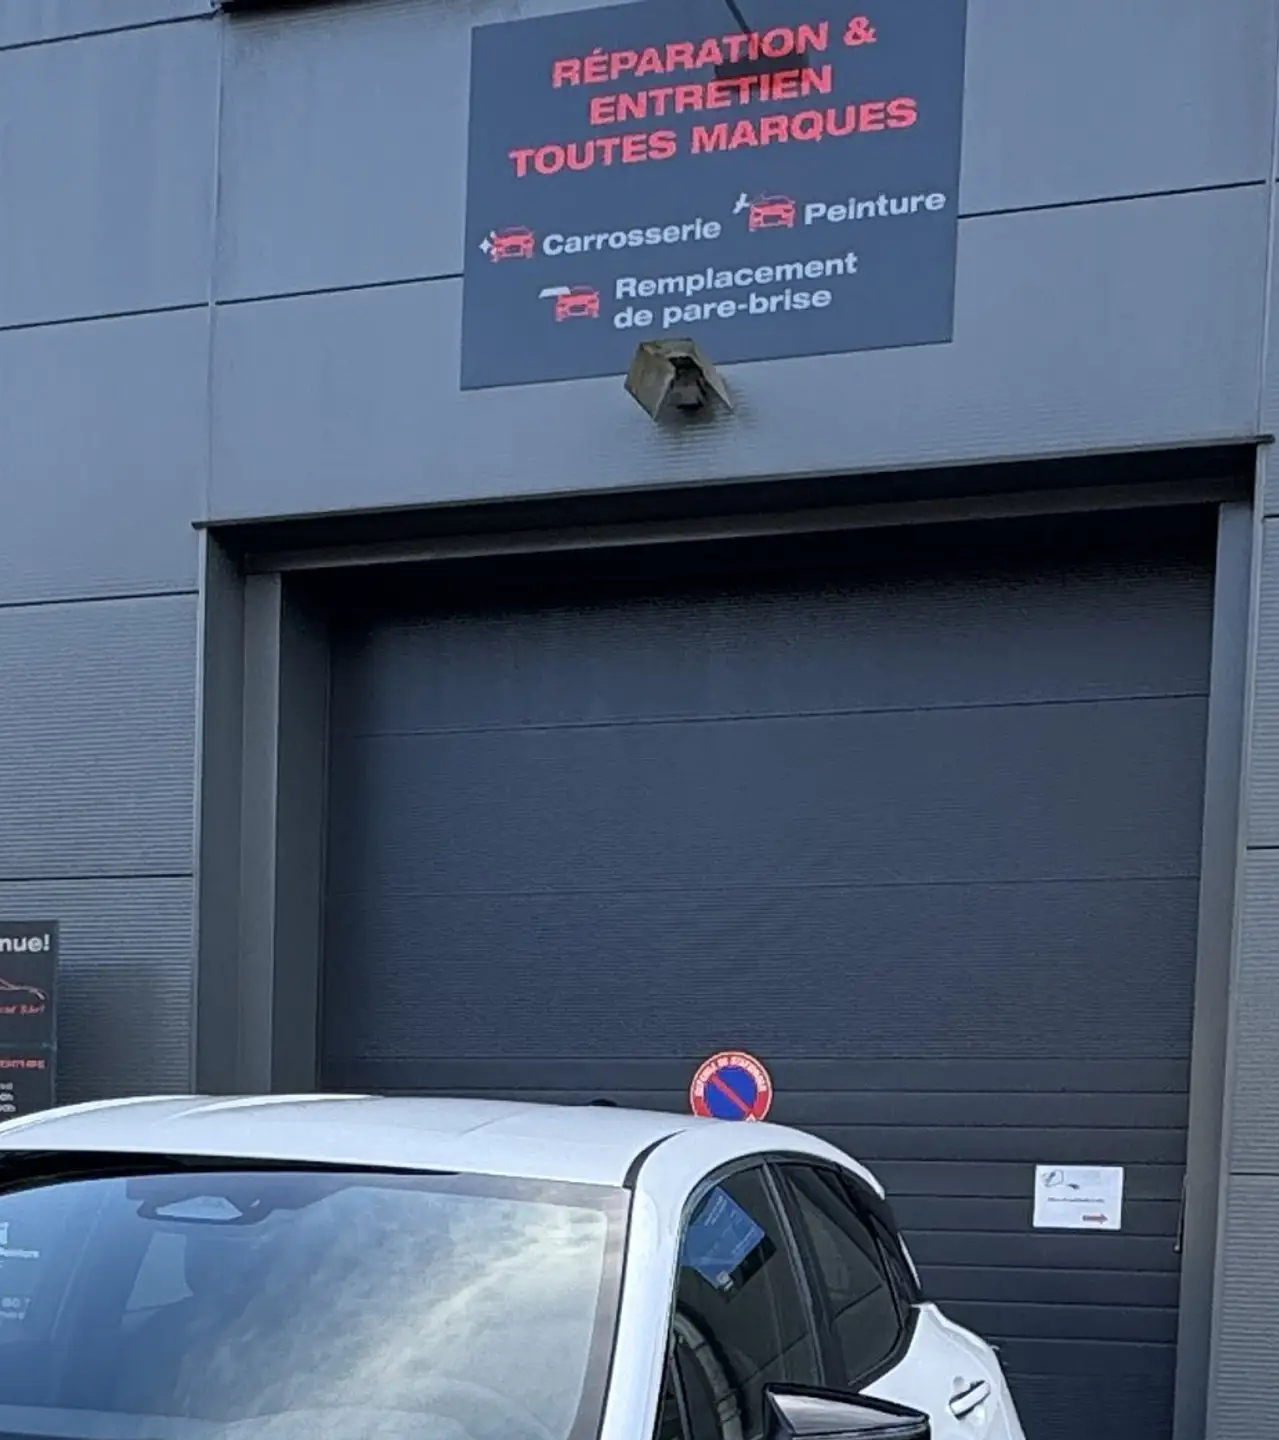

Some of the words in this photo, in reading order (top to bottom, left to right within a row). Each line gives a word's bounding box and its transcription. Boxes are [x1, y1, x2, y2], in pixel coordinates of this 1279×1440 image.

[552, 21, 828, 88] RÉPARATION
[843, 15, 877, 47] &
[589, 65, 832, 126] ENTRETIEN
[509, 129, 677, 178] TOUTES
[691, 97, 918, 154] MARQUES
[804, 191, 946, 227] Peinture
[542, 218, 722, 257] Carrosserie
[615, 251, 859, 300] Remplacement
[613, 304, 654, 331] de
[662, 286, 832, 329] pare-brise
